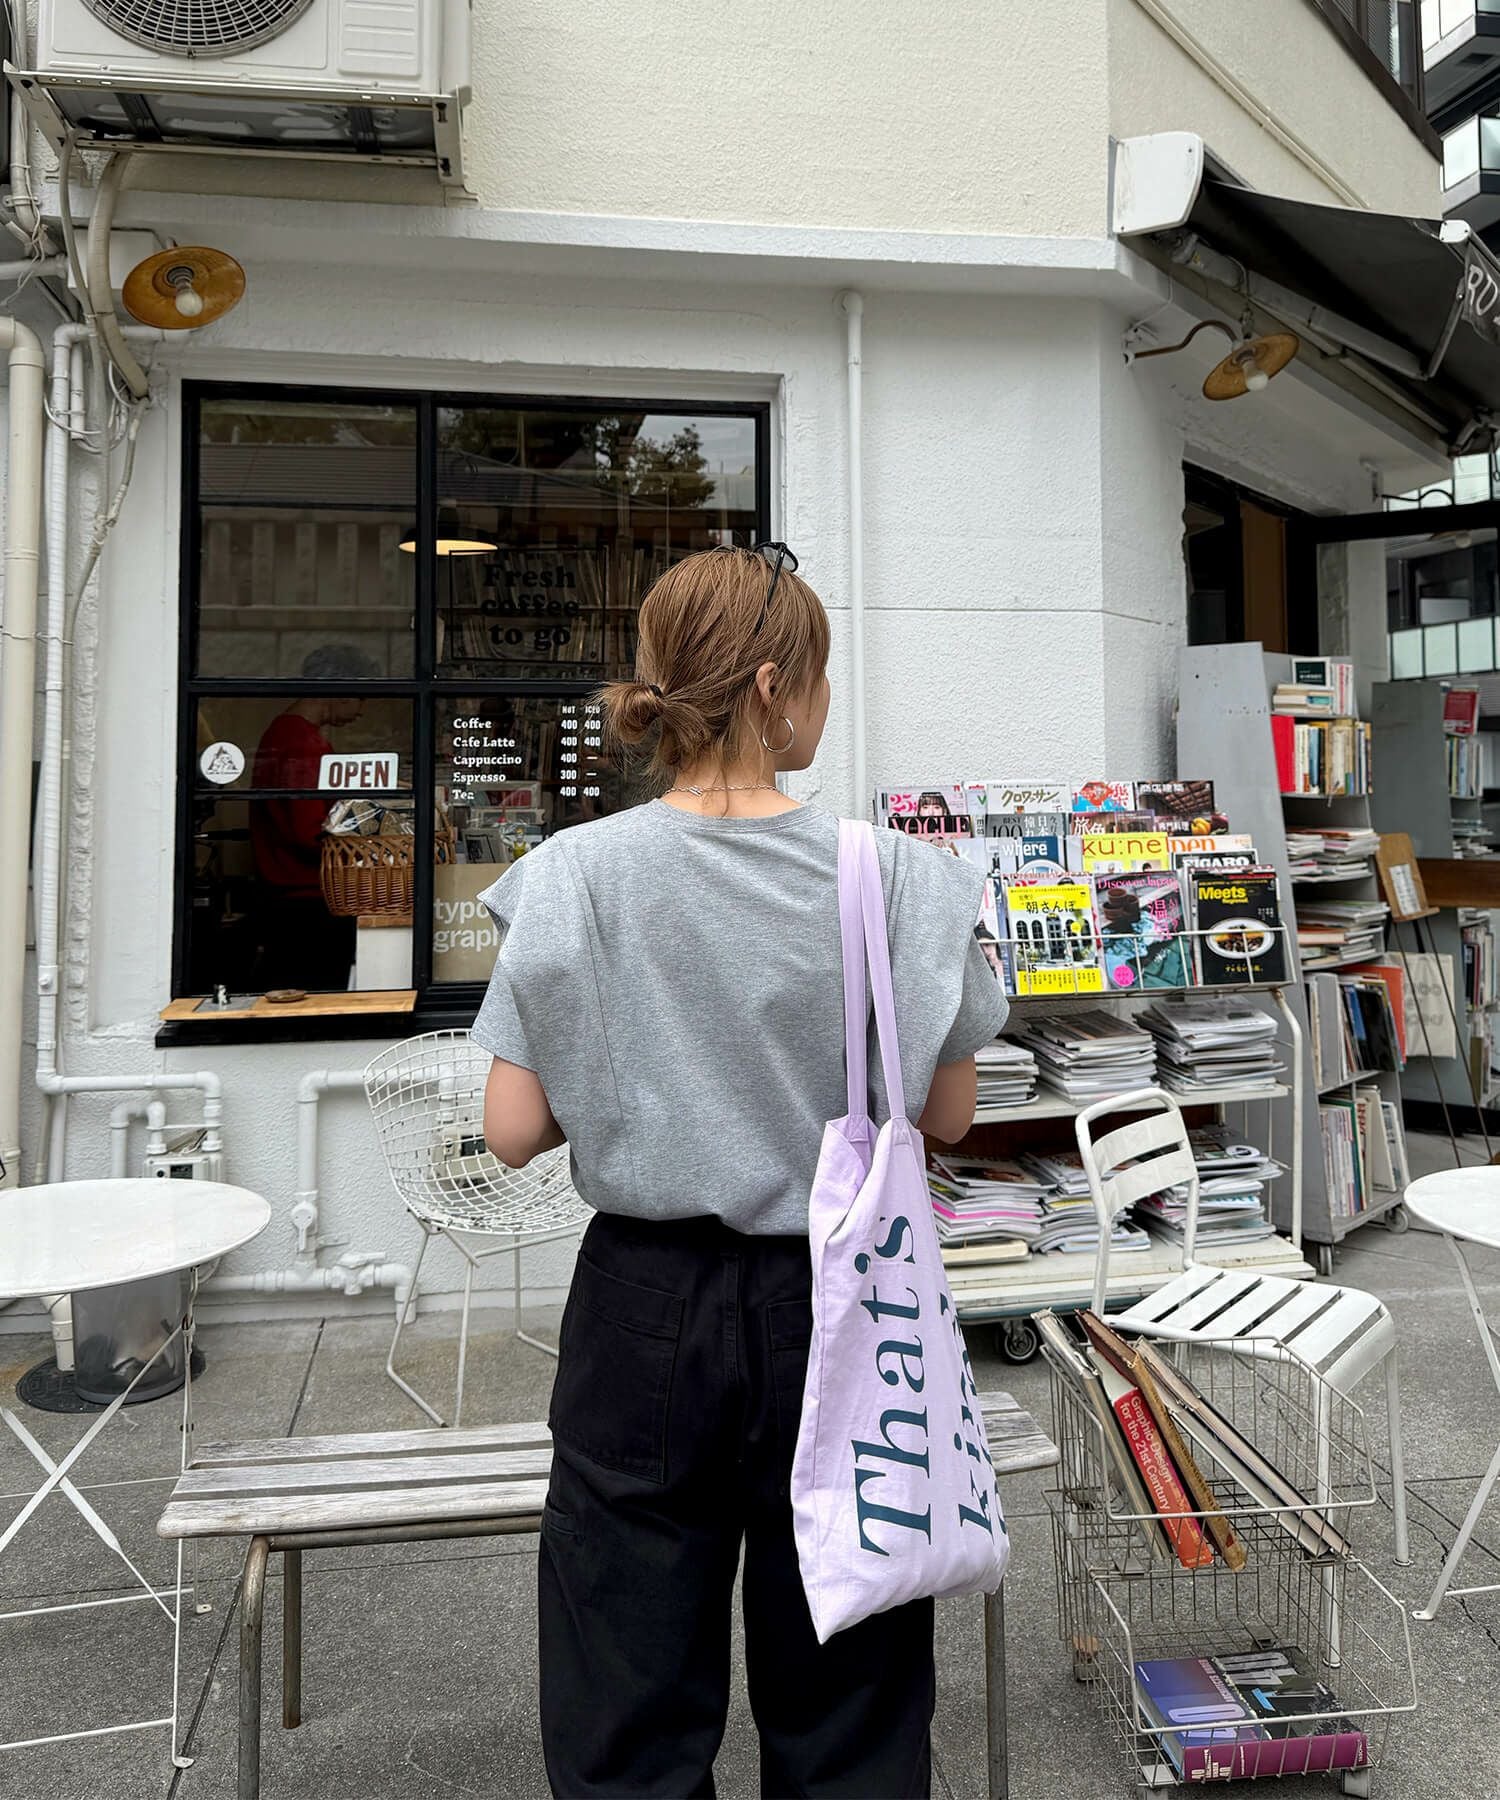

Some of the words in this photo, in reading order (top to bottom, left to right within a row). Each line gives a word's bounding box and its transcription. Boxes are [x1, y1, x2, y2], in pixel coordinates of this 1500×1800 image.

[1468, 263, 1500, 327] RO
[484, 563, 576, 588] Fresh
[481, 593, 580, 617] coffee
[488, 624, 523, 646] to
[535, 628, 571, 651] go
[453, 718, 492, 729] Coffee
[561, 719, 578, 730] 400
[584, 719, 601, 730] 400
[453, 736, 480, 748] Cafe
[483, 736, 516, 748] Latte
[561, 736, 578, 747] 400
[584, 736, 601, 747] 400
[453, 754, 522, 768] Cappuccino
[560, 753, 577, 763] 400
[328, 760, 390, 788] OPEN
[452, 771, 506, 786] Espresso
[560, 769, 577, 780] 300
[560, 786, 577, 796] 400
[583, 786, 600, 796] 400
[888, 815, 971, 840] VOGUE
[1001, 840, 1048, 857] where
[1182, 856, 1250, 869] FIGARO
[1198, 886, 1248, 900] Meets
[850, 1215, 932, 1557] That's
[1131, 1395, 1153, 1441] Graphic
[1149, 1441, 1172, 1483] Design
[1119, 1401, 1133, 1419] for
[1126, 1420, 1142, 1441] the
[1135, 1440, 1152, 1466] 21st
[1145, 1464, 1171, 1511] Century
